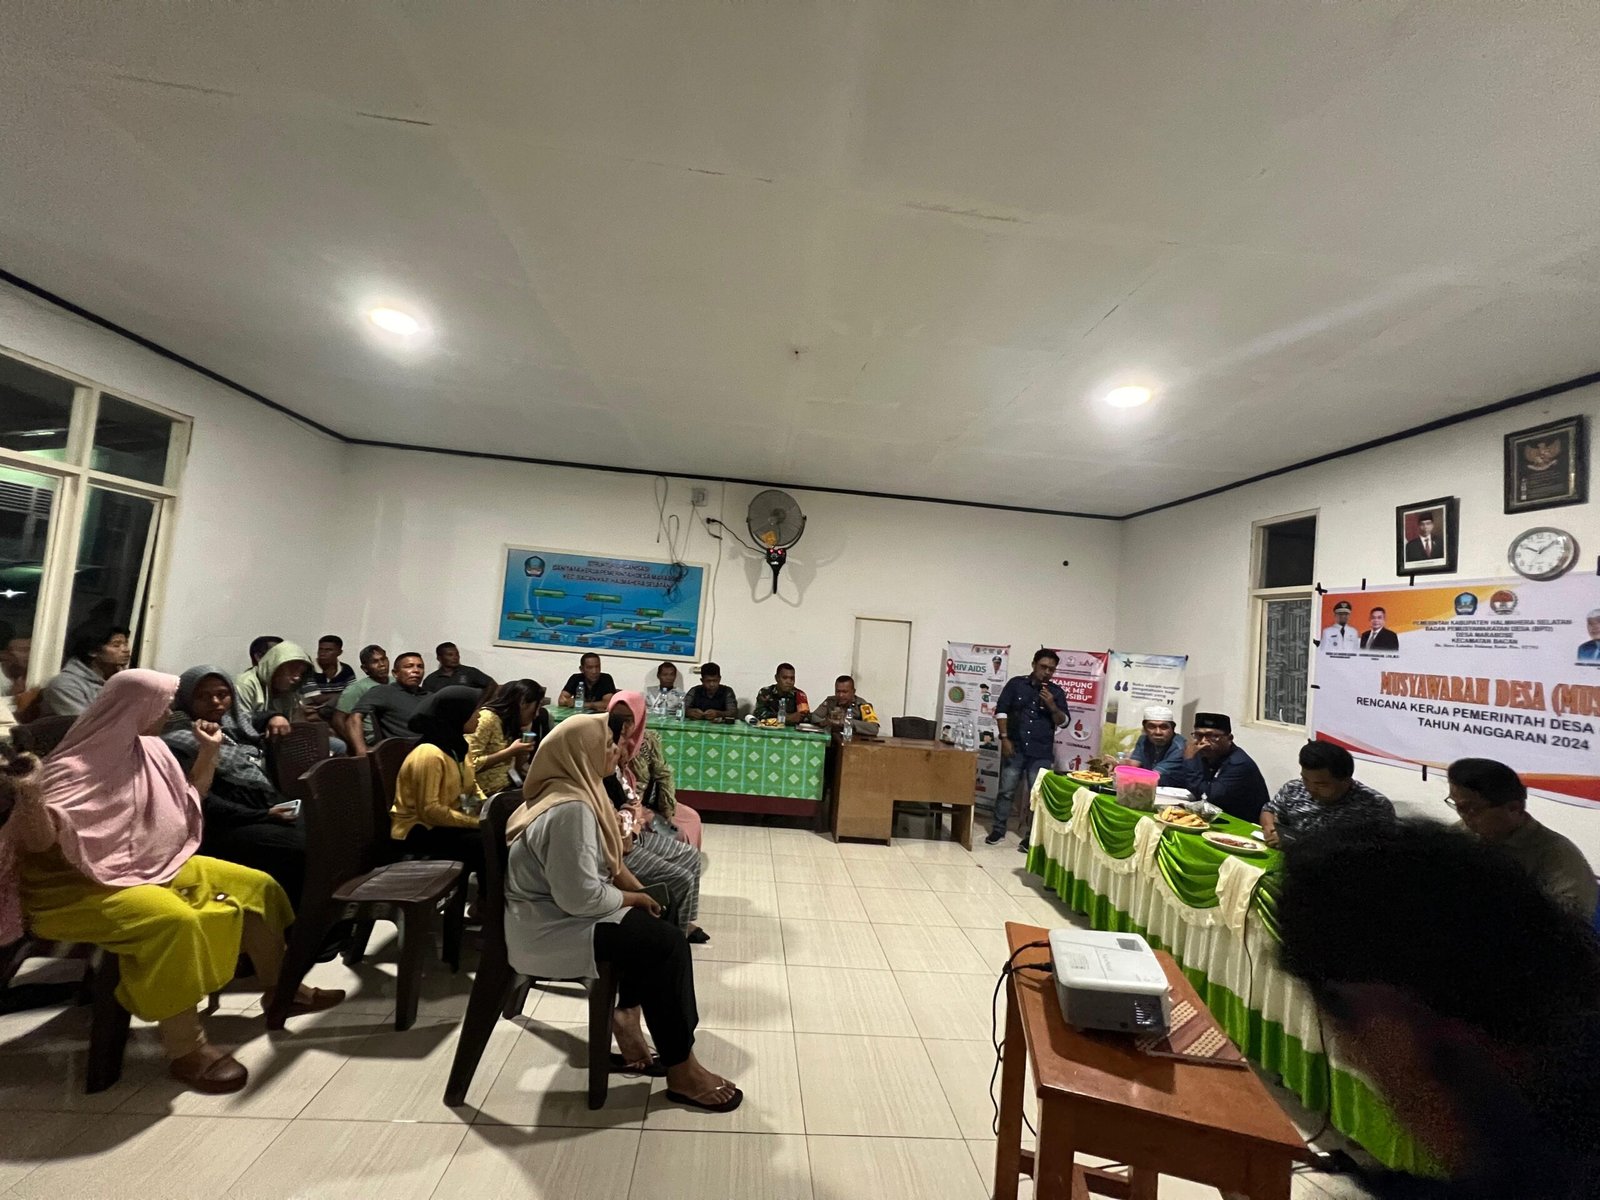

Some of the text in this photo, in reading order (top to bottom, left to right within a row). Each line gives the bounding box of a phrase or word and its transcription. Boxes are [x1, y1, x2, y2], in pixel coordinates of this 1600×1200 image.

[954, 663, 987, 673] HIV AIDS
[1073, 687, 1085, 695] ME
[1380, 671, 1490, 706] MUSYAWARAH
[1495, 679, 1547, 712] DESA
[1356, 696, 1595, 735] RENCANA KERJA PEMERINTAH DESA
[1417, 716, 1590, 751] TAHUN ANGGARAN 2024
